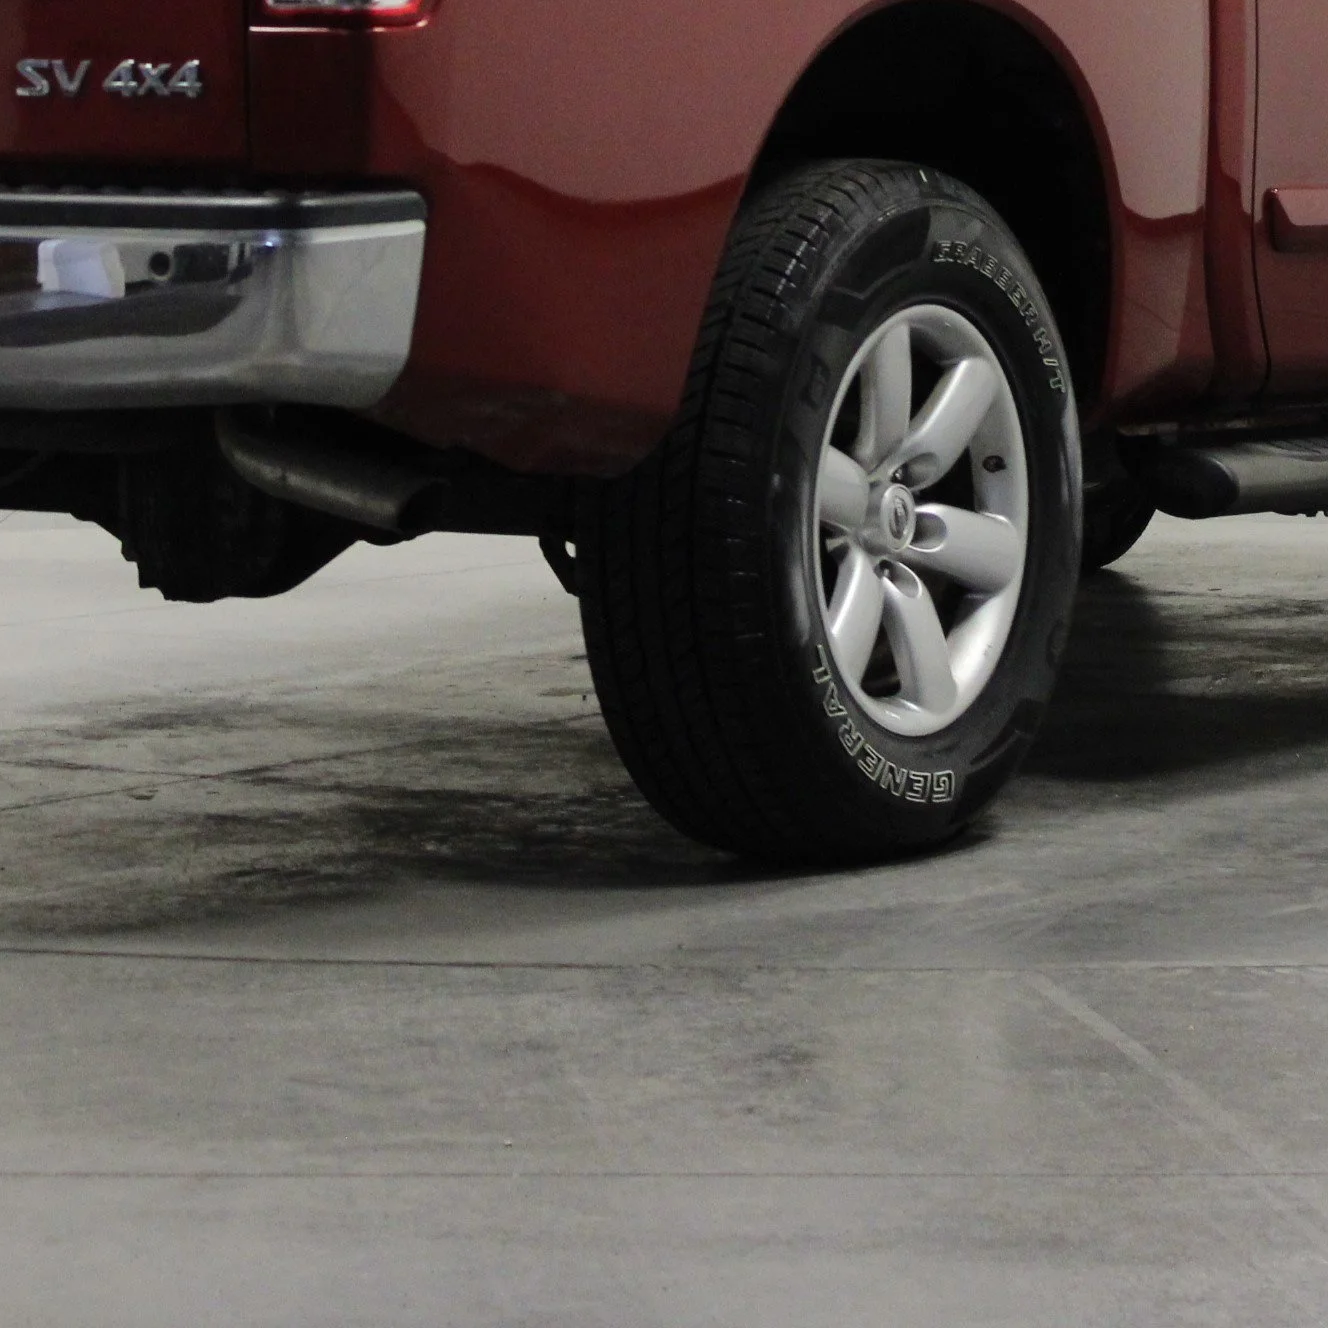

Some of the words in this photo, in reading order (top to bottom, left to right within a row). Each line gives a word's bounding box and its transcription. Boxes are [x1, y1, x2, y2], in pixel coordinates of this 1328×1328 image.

[16, 59, 91, 97] SV
[932, 239, 1039, 327] GRABBER
[1033, 327, 1067, 394] H/T
[812, 643, 956, 803] GENERAL
